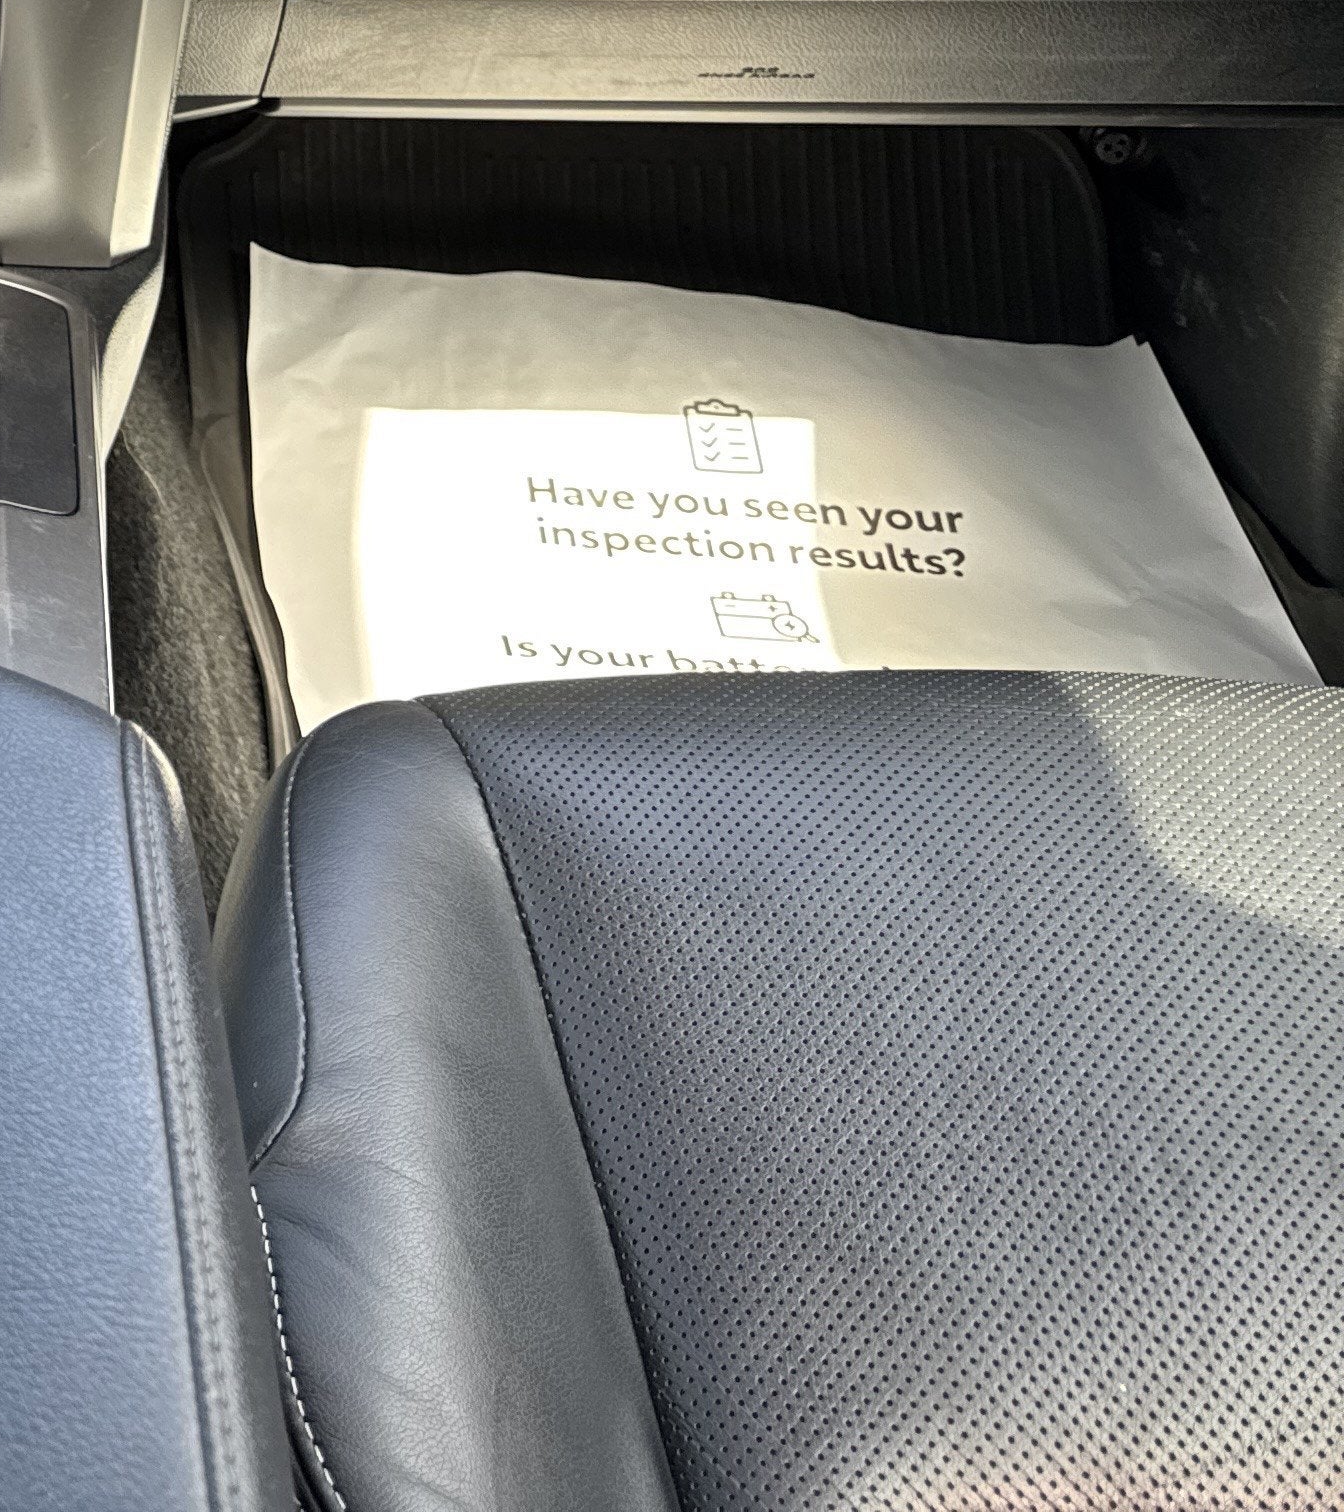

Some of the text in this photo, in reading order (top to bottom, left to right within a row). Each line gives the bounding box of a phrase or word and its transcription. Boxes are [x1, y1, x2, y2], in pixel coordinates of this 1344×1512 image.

[526, 476, 964, 536] Have you seen your
[538, 517, 966, 577] inspection results?
[501, 634, 538, 659] Is
[550, 641, 655, 668] your
